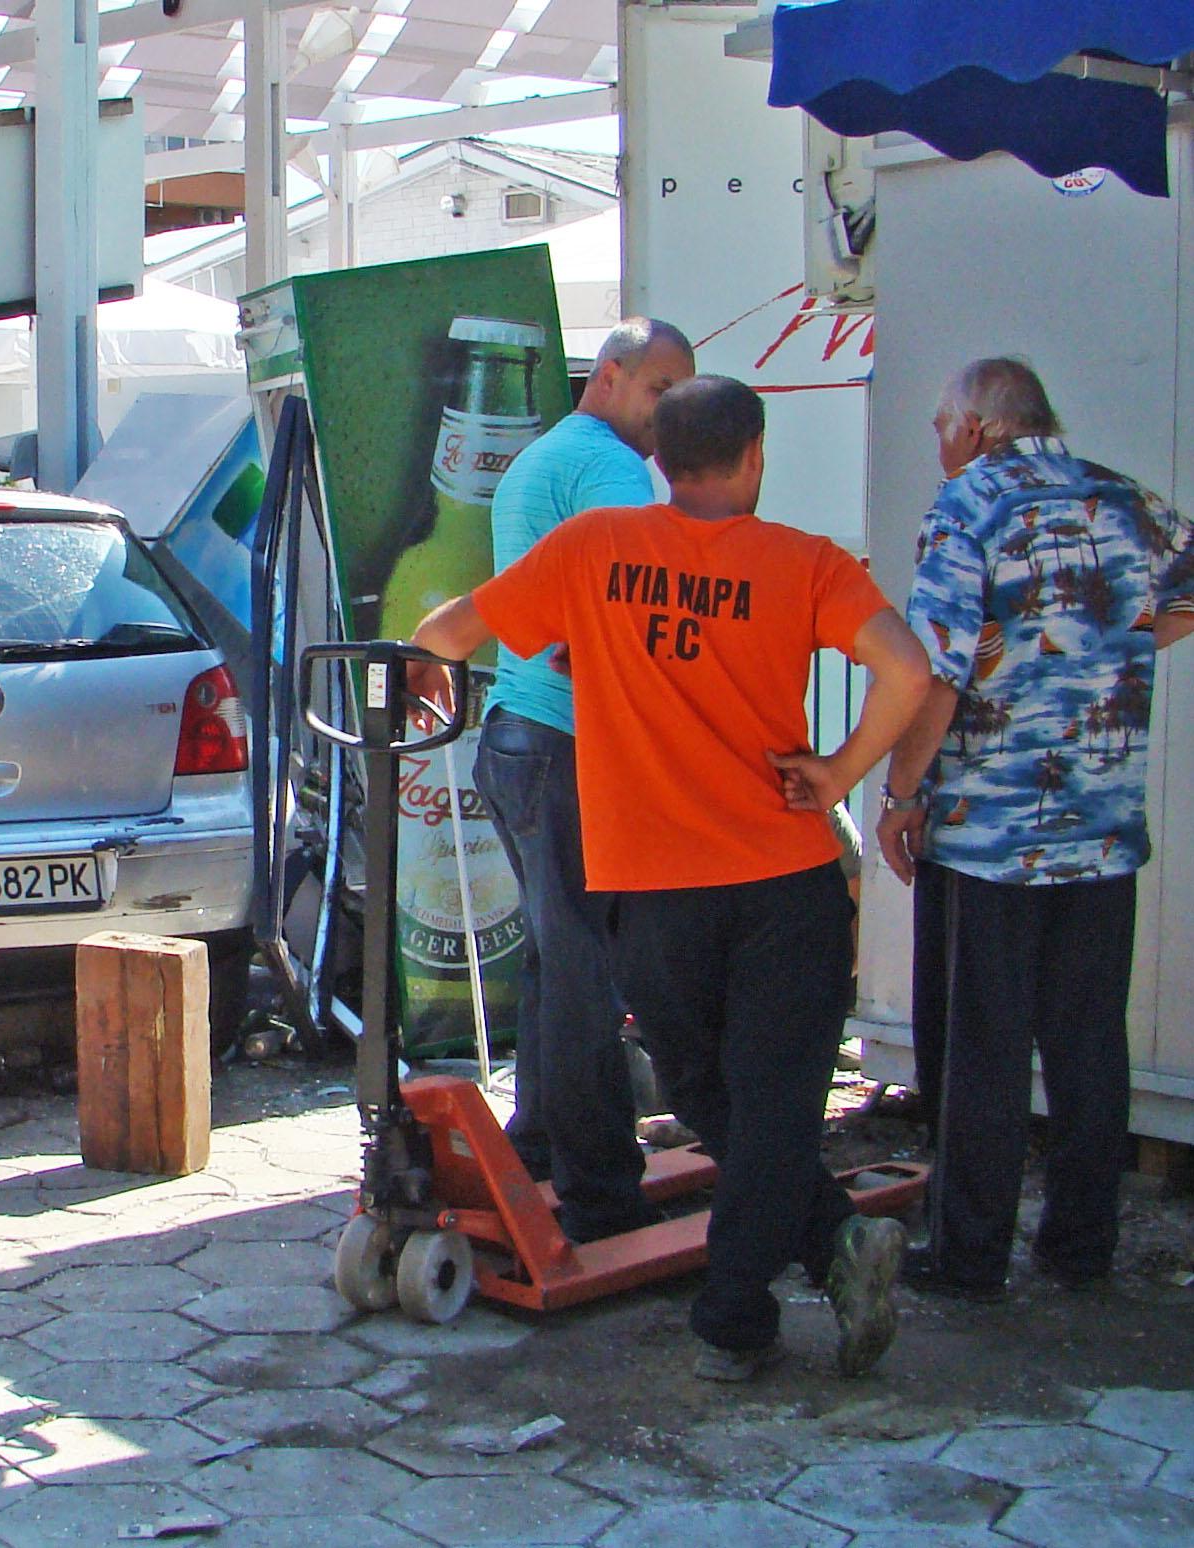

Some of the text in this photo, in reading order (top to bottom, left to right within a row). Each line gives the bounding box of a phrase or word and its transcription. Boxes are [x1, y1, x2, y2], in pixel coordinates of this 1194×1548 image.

[607, 562, 751, 621] AYIA NAPA
[410, 920, 521, 957] GER EER
